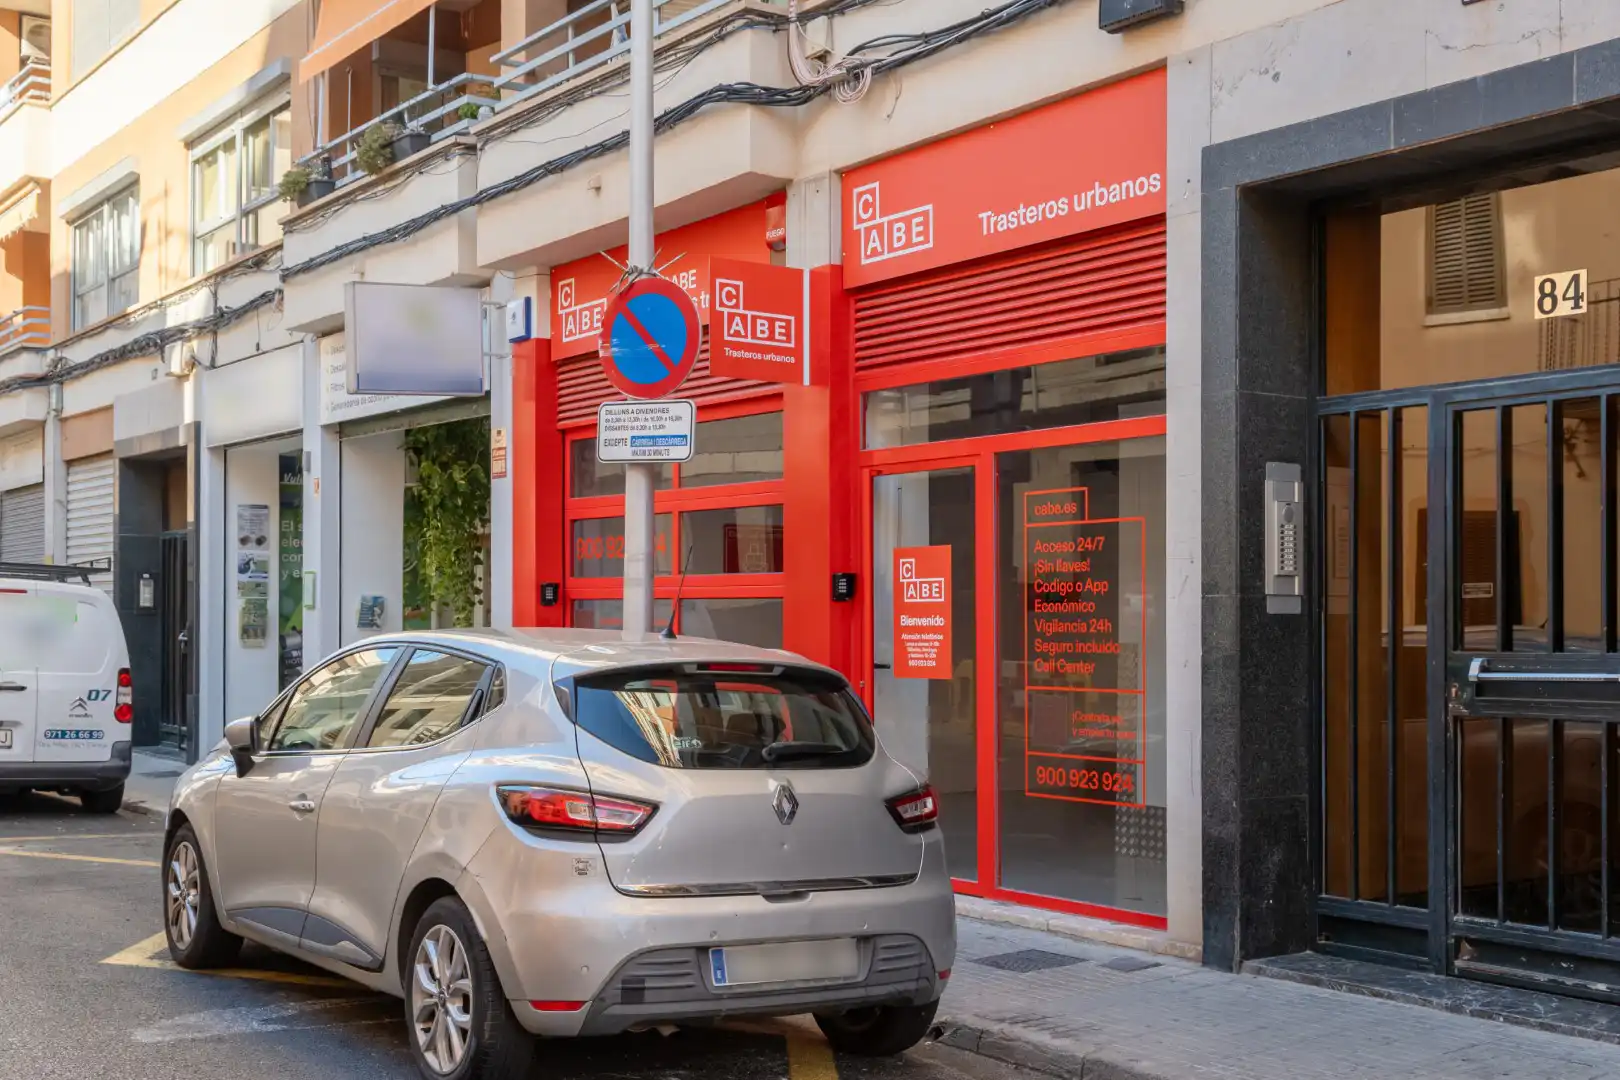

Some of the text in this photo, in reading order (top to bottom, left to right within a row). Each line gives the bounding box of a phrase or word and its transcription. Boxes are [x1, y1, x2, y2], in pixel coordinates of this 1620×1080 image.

[978, 172, 1161, 236] Trasteros urbanos
[668, 269, 697, 290] ABE
[1537, 273, 1584, 315] 84
[723, 346, 795, 364] Trasteros urbanos
[635, 407, 670, 415] DIVENDRES
[603, 438, 628, 447] EXCEPTE
[1034, 501, 1077, 516] cabe.es
[281, 520, 293, 532] El
[281, 536, 304, 548] ele
[606, 534, 625, 559] 92
[1034, 535, 1106, 553] Acceso 24/7
[1056, 557, 1090, 573] llaves!
[1075, 583, 1082, 592] o
[1083, 577, 1109, 595] App
[1034, 599, 1096, 613] Económico
[900, 614, 945, 626] Bienvenido
[1034, 618, 1112, 636] Vigilancia 24h
[1034, 638, 1121, 656] Seguro incluido
[1033, 657, 1096, 675] Call Center
[86, 689, 112, 701] 07
[45, 730, 104, 739] 971 26 66 99
[1036, 765, 1134, 793] 900 923 924
